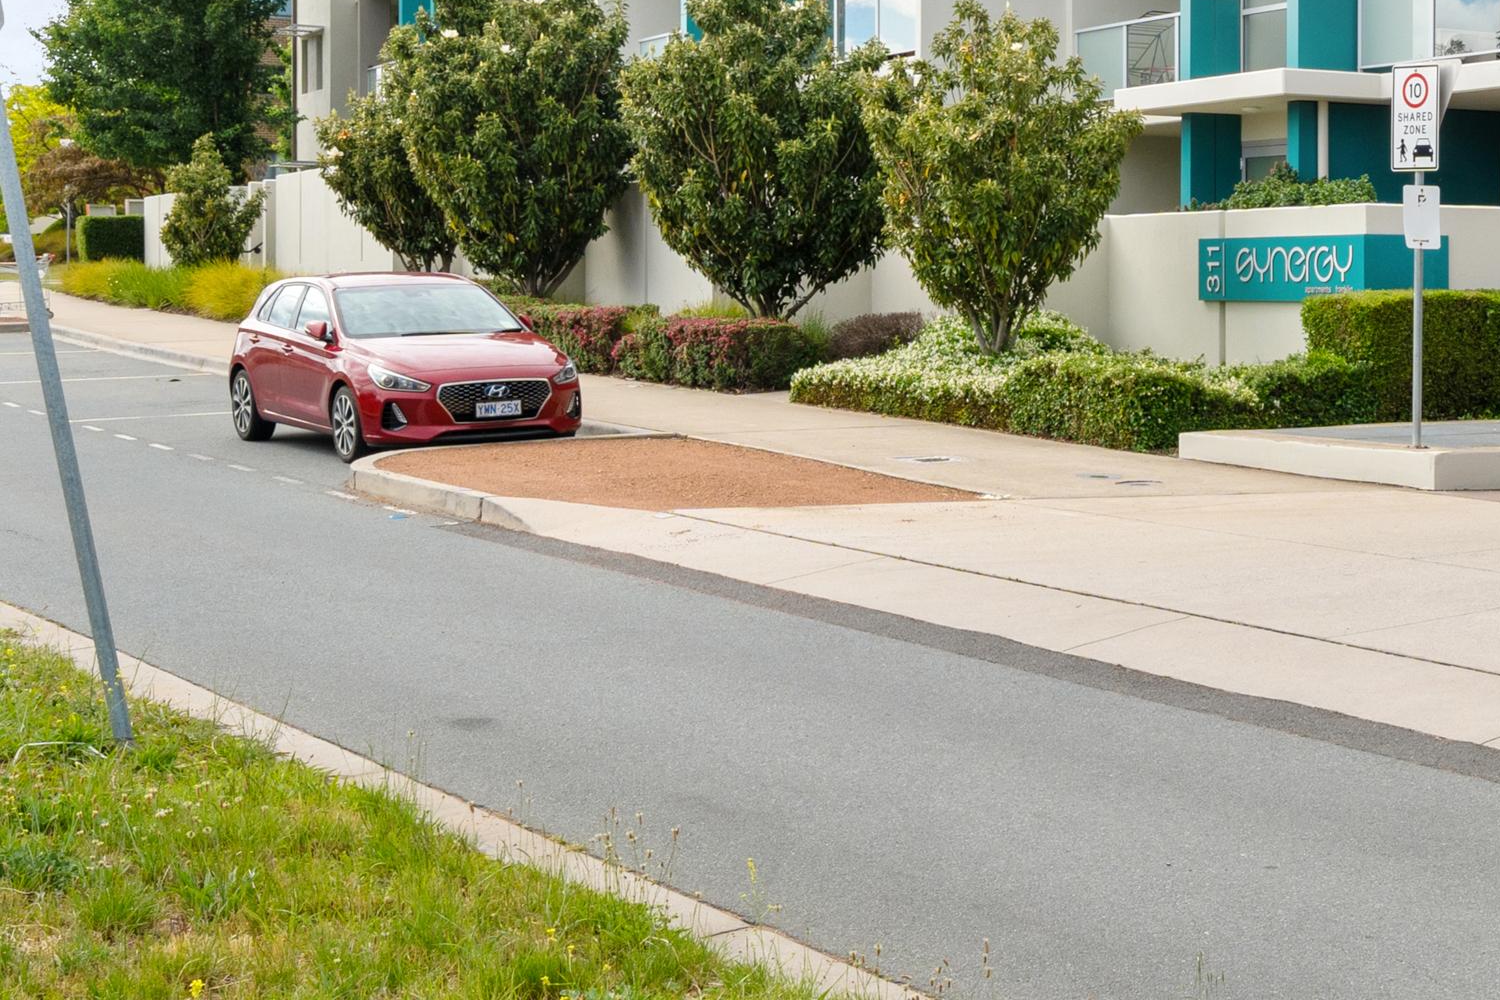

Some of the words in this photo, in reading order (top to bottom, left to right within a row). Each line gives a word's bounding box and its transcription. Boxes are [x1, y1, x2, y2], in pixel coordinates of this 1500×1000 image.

[1409, 83, 1421, 98] 10
[1398, 112, 1433, 122] SHARED
[1403, 125, 1427, 135] ZONE
[1206, 246, 1220, 293] 311
[500, 402, 520, 414] 25X
